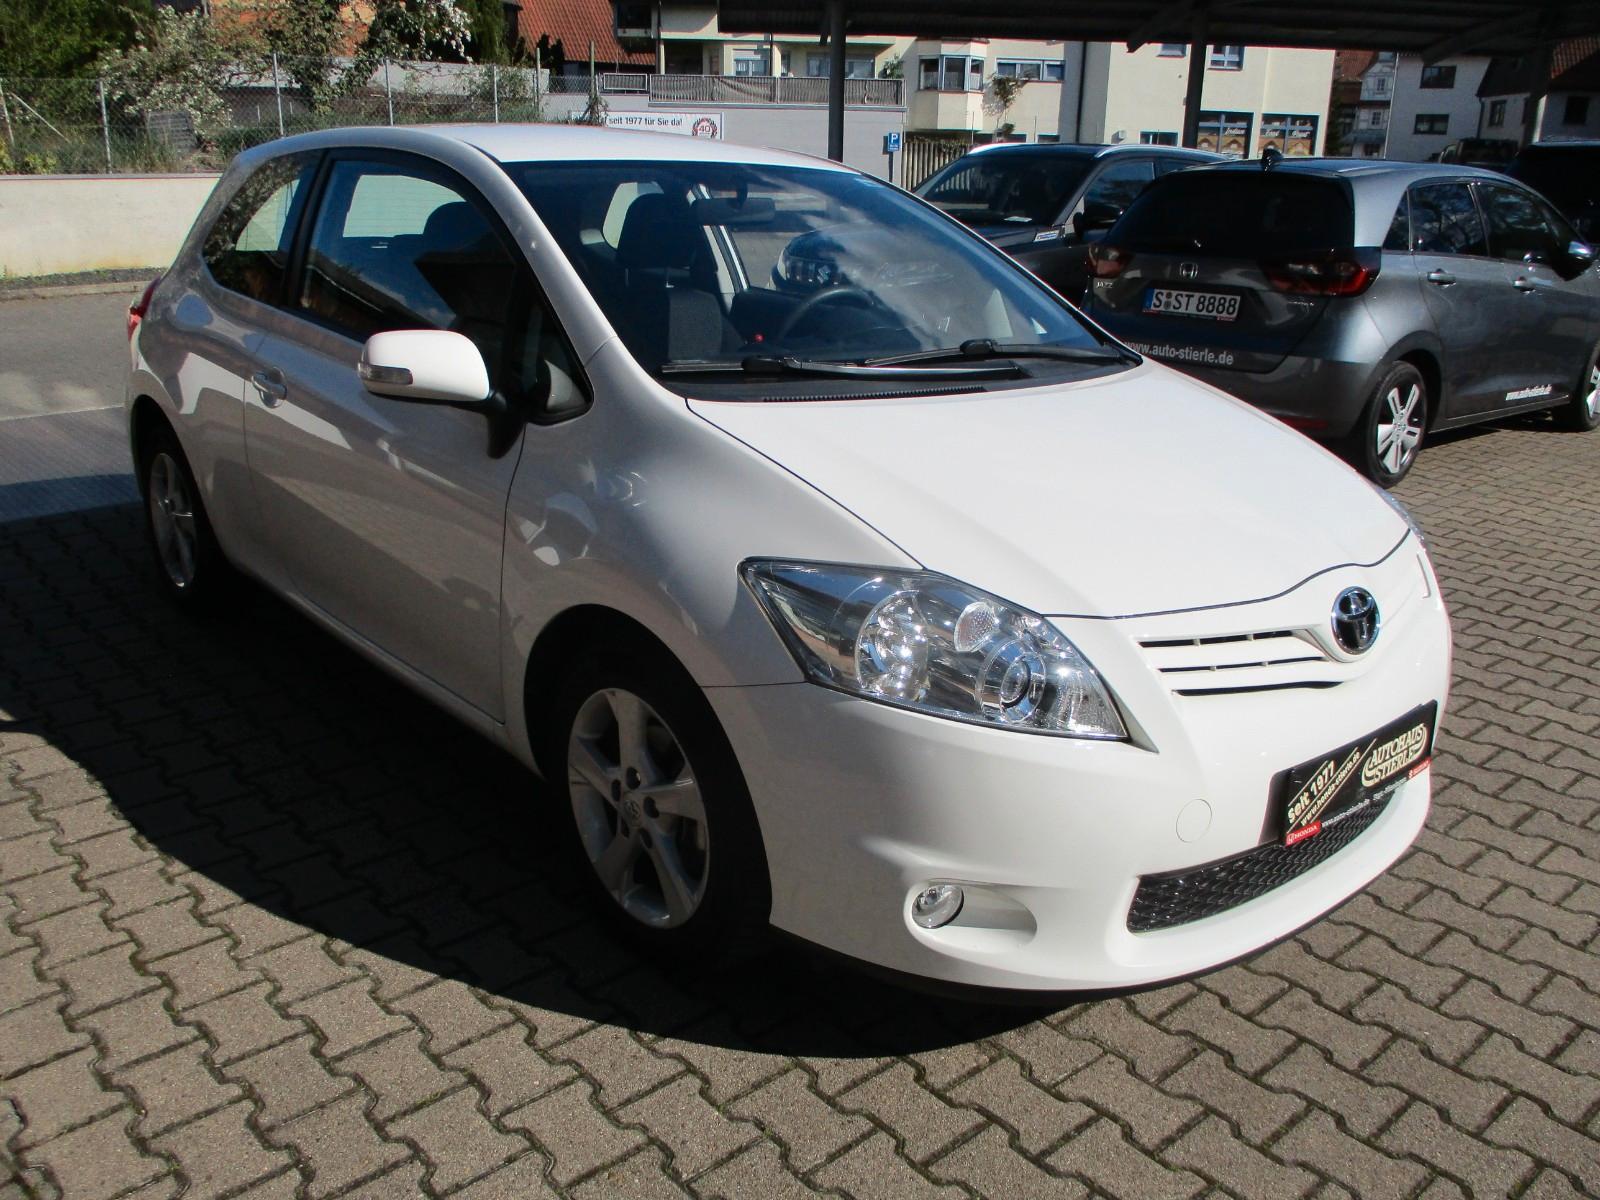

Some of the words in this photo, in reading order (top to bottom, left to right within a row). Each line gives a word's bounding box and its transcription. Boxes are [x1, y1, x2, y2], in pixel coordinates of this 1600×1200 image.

[609, 116, 623, 125] seit
[625, 116, 643, 126] 1977
[645, 116, 655, 126] für
[657, 117, 669, 126] Sie
[671, 117, 683, 127] da!
[891, 133, 899, 143] P
[1153, 291, 1165, 308] S
[1196, 296, 1237, 315] 8888
[1124, 342, 1234, 365] www.auto-stierle.de
[1368, 722, 1426, 769] AUTOHAUS
[1374, 746, 1418, 782] STIERLE
[1287, 791, 1311, 825] seit
[1310, 760, 1336, 796] 1977
[1294, 825, 1317, 839] HONDA
